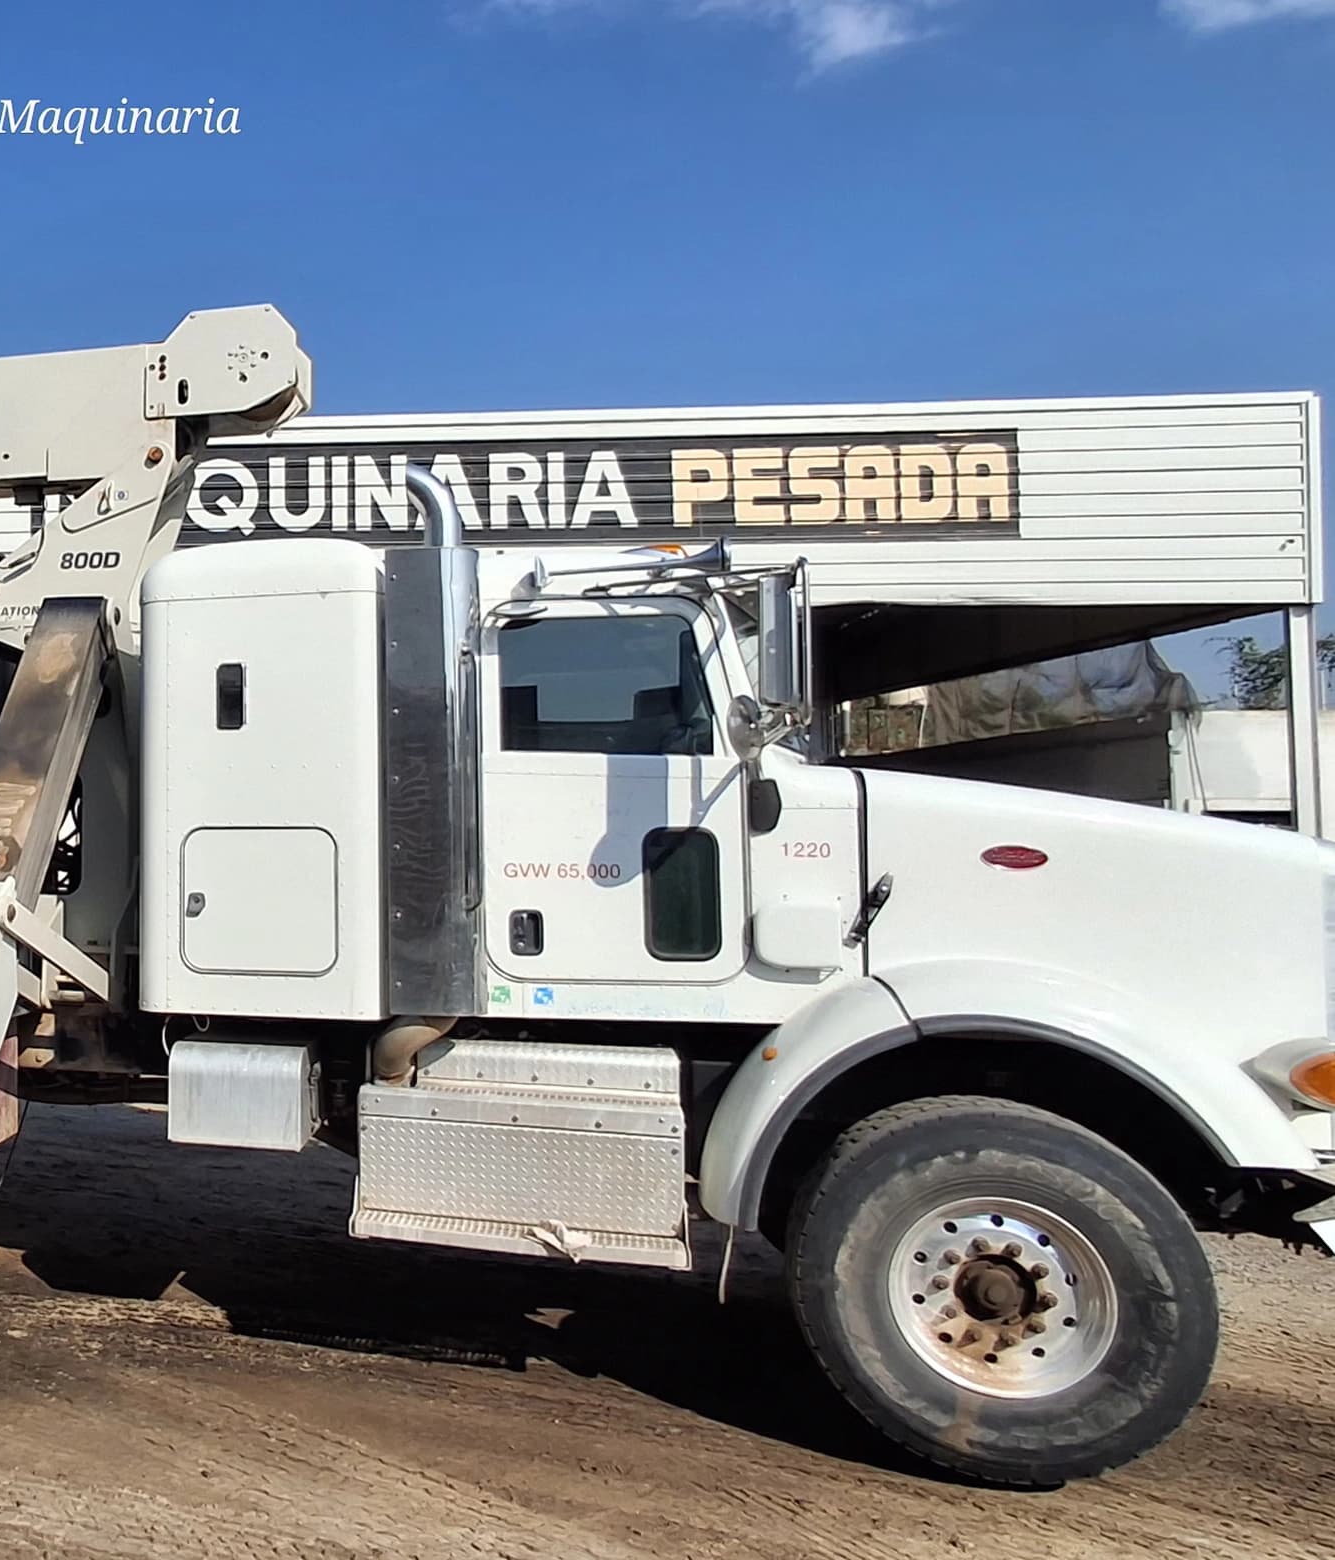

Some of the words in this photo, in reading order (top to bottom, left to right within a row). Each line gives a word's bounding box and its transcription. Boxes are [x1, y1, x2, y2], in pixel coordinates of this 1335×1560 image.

[185, 448, 639, 536] QUINARIA
[670, 443, 1011, 528] PESADA
[60, 551, 121, 570] 800D
[782, 842, 832, 858] 1220
[503, 862, 551, 879] GVW
[557, 862, 622, 881] 65,000
